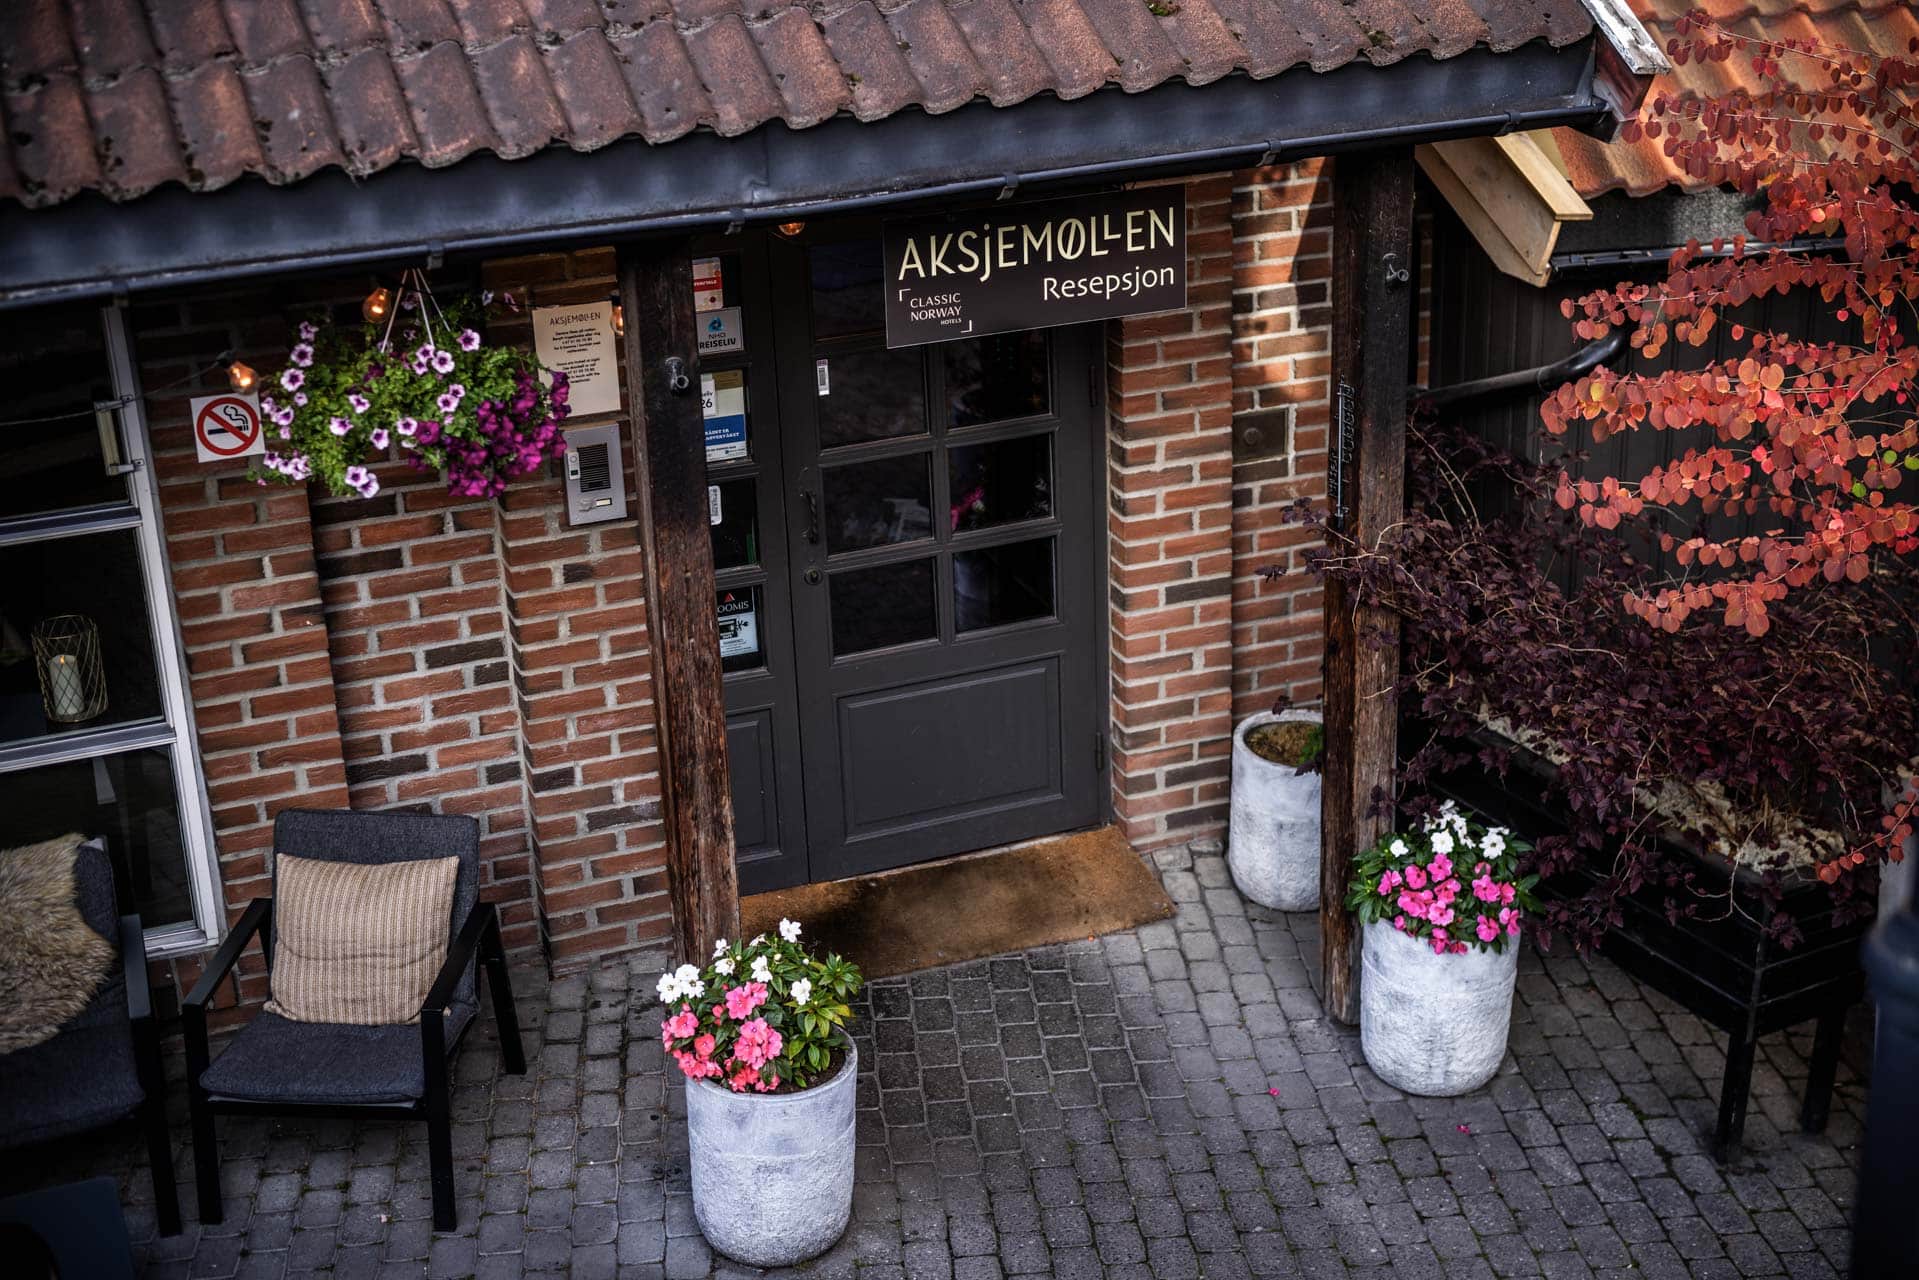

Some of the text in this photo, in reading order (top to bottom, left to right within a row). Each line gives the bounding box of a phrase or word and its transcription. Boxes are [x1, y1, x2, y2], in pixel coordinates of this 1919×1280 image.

[1043, 266, 1174, 300] Resepsjon
[910, 292, 961, 309] CLASSIC
[910, 305, 962, 322] NORWAY
[940, 317, 962, 326] HOTELS
[699, 338, 736, 349] REISELIV
[702, 398, 713, 409] 26
[717, 600, 749, 613] OOMIS
